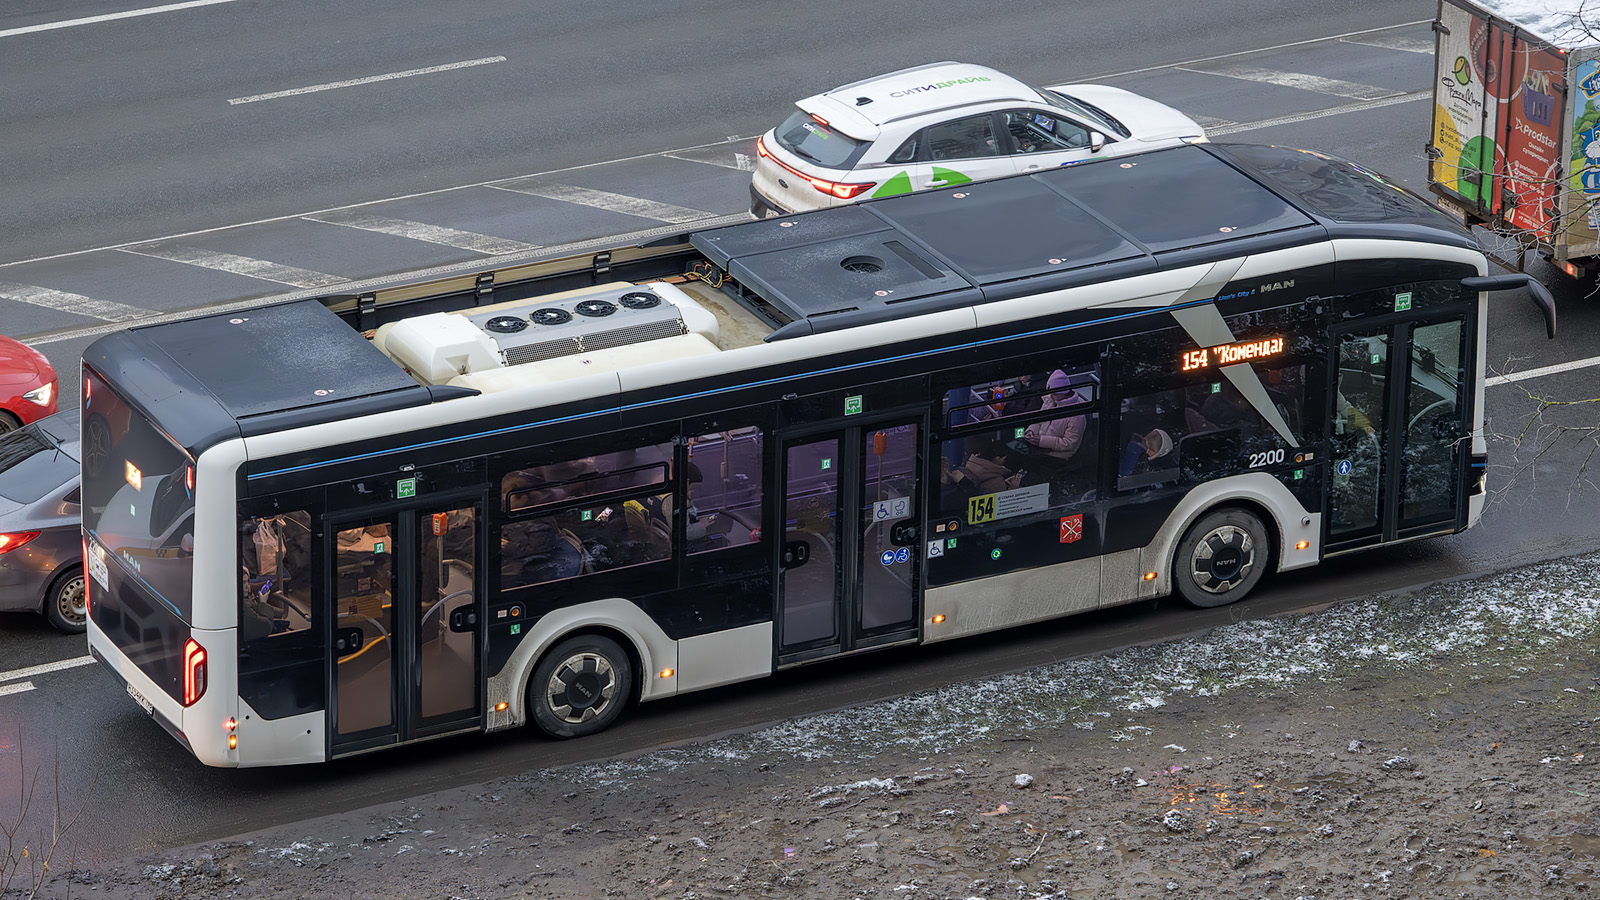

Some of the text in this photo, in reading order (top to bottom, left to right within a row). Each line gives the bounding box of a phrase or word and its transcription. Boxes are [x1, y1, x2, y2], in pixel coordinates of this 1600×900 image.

[890, 77, 992, 98] СИТИДРАЙВ
[1522, 124, 1557, 149] Prodstar
[1260, 279, 1295, 293] MAN
[1183, 349, 1208, 371] 154
[1249, 448, 1285, 469] 2200
[970, 496, 994, 523] 154
[123, 549, 141, 572] MAN
[575, 682, 592, 698] MAN
